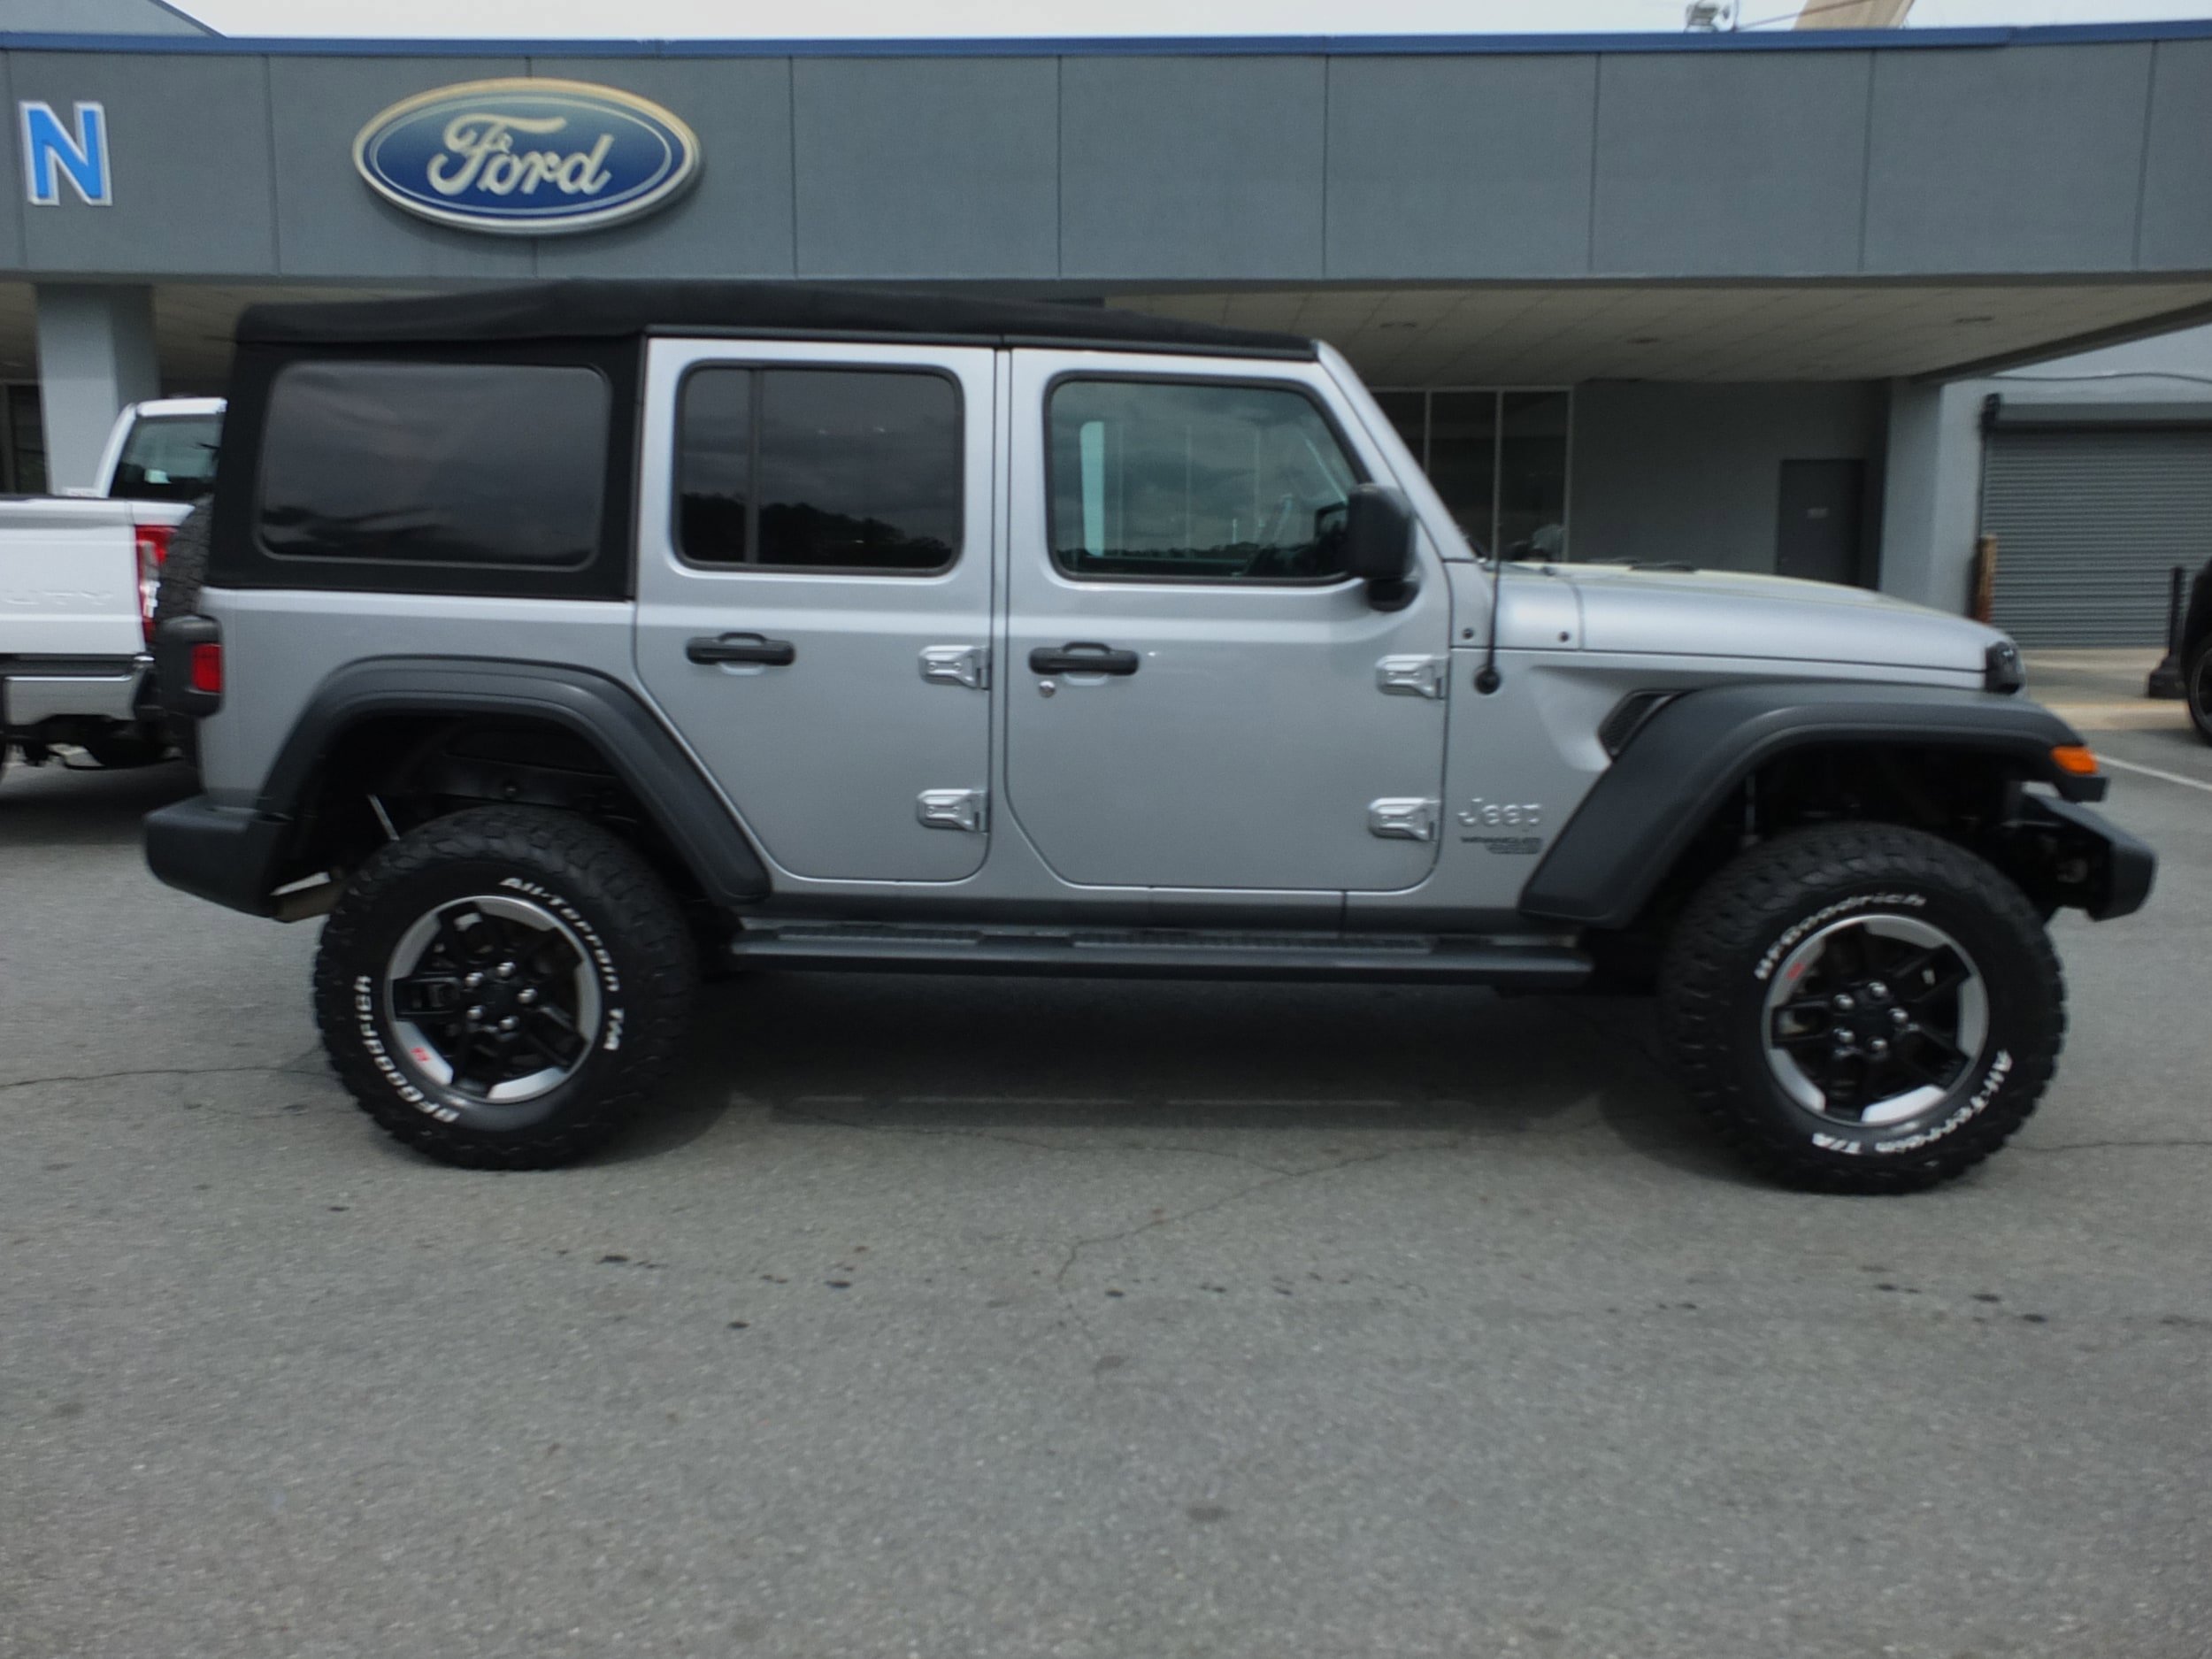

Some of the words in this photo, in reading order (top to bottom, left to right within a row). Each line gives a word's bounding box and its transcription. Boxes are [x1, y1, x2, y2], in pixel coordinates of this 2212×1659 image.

[19, 100, 114, 207] N
[428, 112, 616, 196] Ford
[1458, 796, 1542, 832] Jeep
